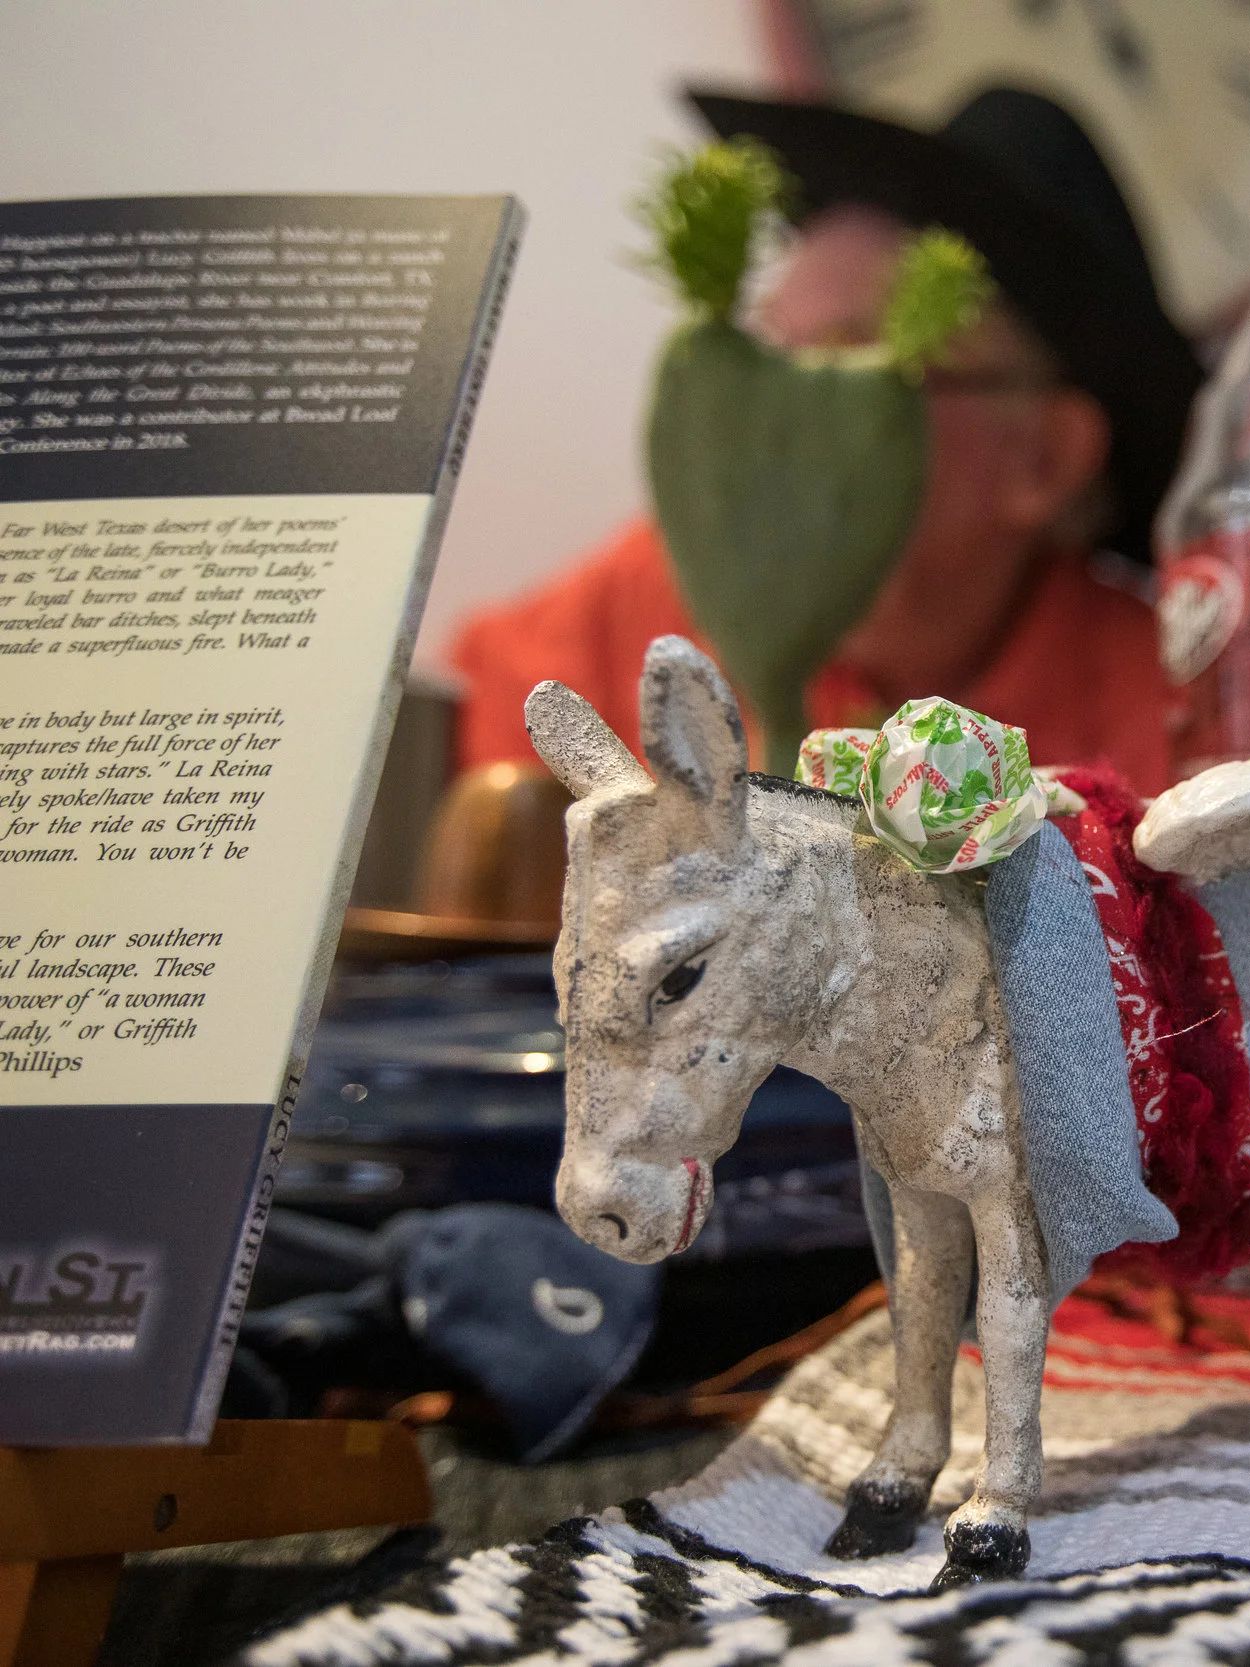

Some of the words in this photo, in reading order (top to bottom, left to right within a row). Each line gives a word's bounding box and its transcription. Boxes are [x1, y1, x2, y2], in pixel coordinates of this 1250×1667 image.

[13, 570, 36, 584] as
[159, 566, 182, 581] or
[25, 590, 74, 611] loyal
[82, 588, 138, 605] burro
[146, 586, 187, 605] and
[195, 586, 245, 602] what
[253, 586, 326, 605] meager
[71, 611, 105, 630] bar
[188, 608, 237, 631] slept
[241, 607, 317, 626] beneath
[48, 639, 61, 654] a
[67, 634, 183, 657] superfluous
[238, 632, 291, 649] What
[297, 635, 311, 649] a
[18, 713, 42, 729] in
[46, 711, 96, 732] body
[100, 710, 137, 727] but
[139, 709, 192, 731] large
[198, 708, 220, 726] in
[223, 707, 286, 730] spirit,
[86, 735, 118, 754] the
[118, 733, 162, 757] full
[159, 733, 216, 756] force
[220, 732, 244, 756] of
[244, 732, 282, 751] her
[40, 761, 90, 781] with
[175, 760, 204, 778] La
[210, 759, 274, 778] Reina
[163, 786, 220, 805] taken
[229, 789, 266, 809] my
[0, 816, 40, 841] for
[48, 815, 81, 834] the
[90, 814, 134, 834] ride
[141, 820, 165, 833] as
[176, 812, 257, 838] Griffith
[958, 801, 1000, 832] APPLE
[96, 843, 137, 861] You
[150, 842, 215, 861] won't
[224, 841, 250, 860] be
[24, 929, 66, 955] for
[75, 932, 116, 949] our
[126, 928, 224, 948] southern
[27, 959, 139, 984] landscape.
[153, 957, 217, 977] These
[66, 987, 96, 1015] of
[125, 991, 207, 1008] woman
[78, 1023, 105, 1040] or
[114, 1018, 198, 1046] Griffith
[268, 1074, 302, 1166] LUCY
